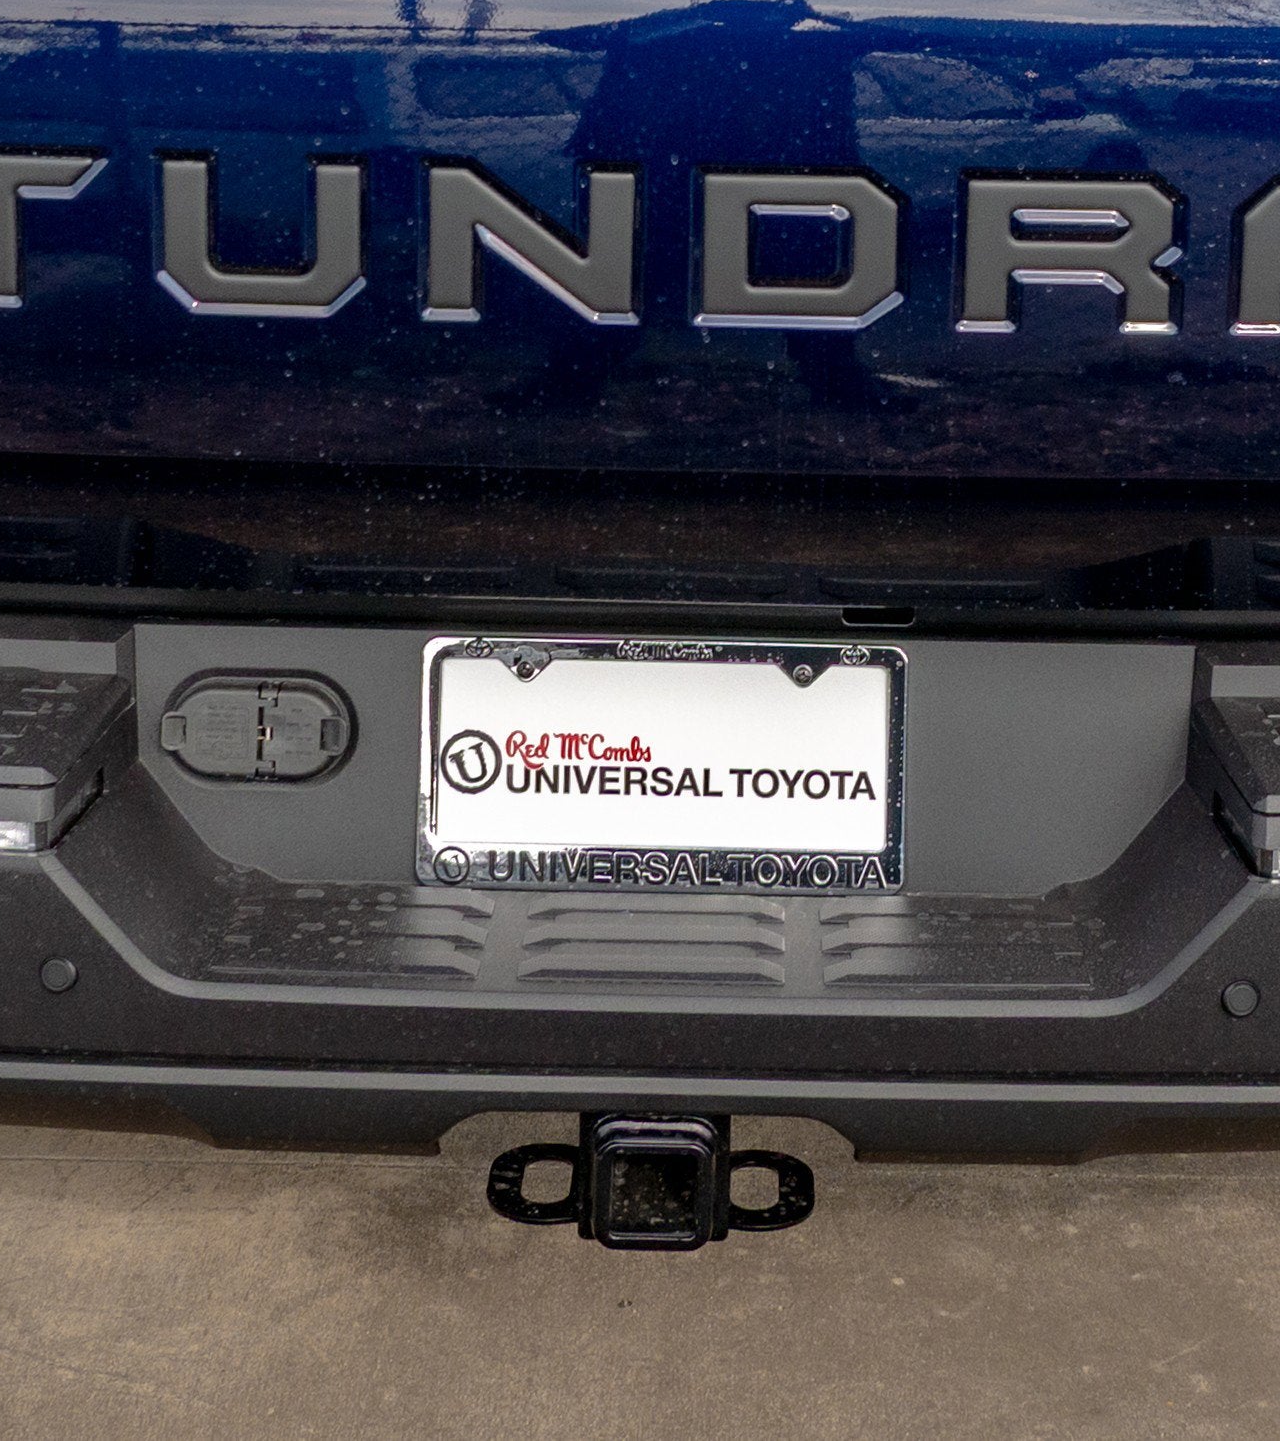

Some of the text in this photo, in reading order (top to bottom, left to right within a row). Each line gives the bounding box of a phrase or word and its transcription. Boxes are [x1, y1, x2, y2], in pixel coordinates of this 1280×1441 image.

[506, 729, 551, 769] Red
[506, 764, 877, 800] UNIVERSAL TOYOTA
[489, 847, 888, 890] UNIVERSAL TOYOTA
